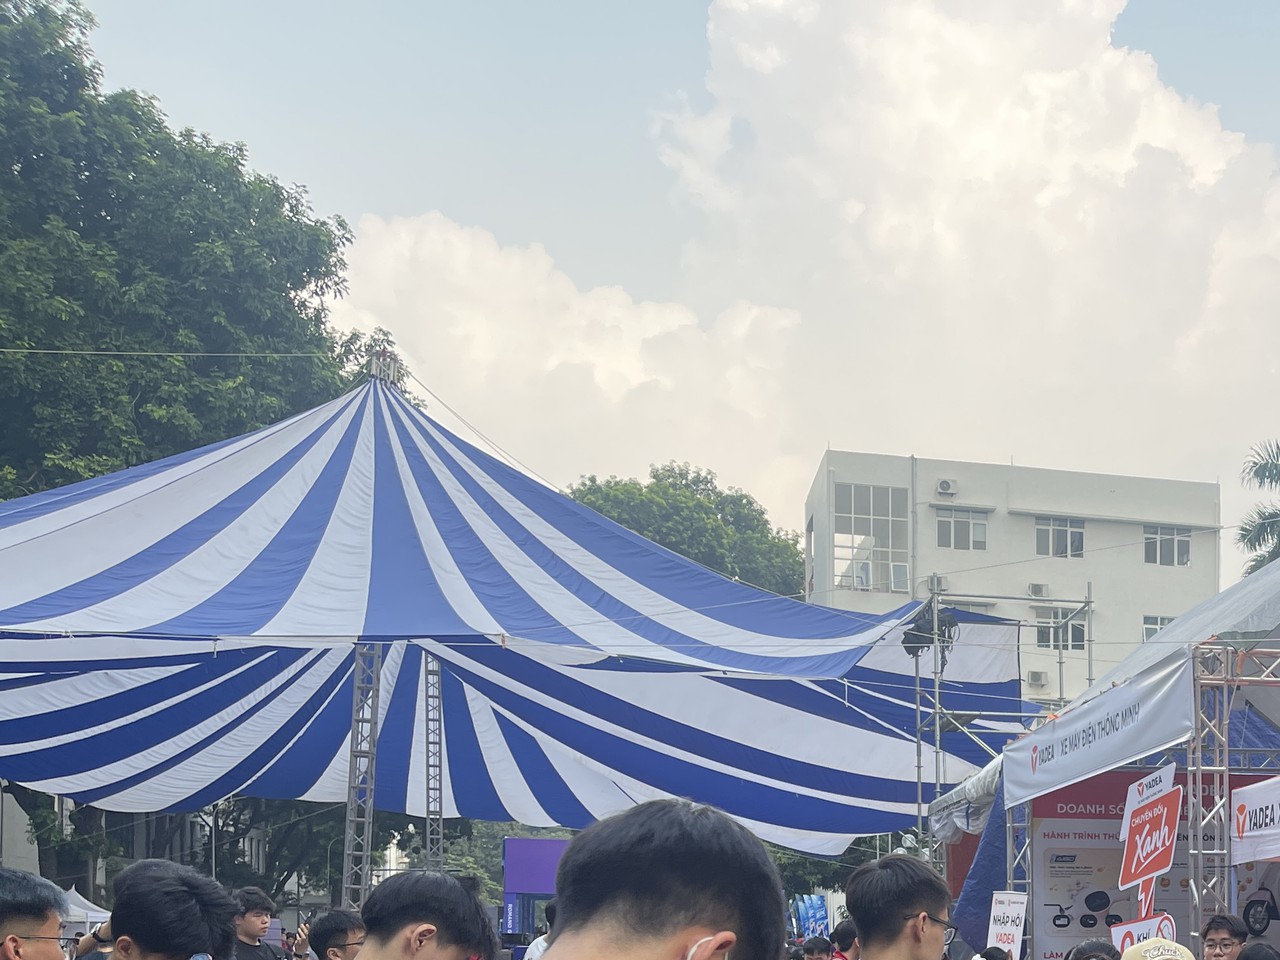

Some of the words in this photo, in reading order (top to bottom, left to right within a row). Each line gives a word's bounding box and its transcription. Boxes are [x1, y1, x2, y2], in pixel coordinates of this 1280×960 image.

[1038, 744, 1055, 766] YADEA
[1060, 738, 1068, 757] XE
[1082, 722, 1096, 749] ĐIỆN
[1097, 712, 1120, 740] THÔNG
[1120, 702, 1140, 730] MINH
[1144, 775, 1163, 792] YADEA
[1057, 803, 1105, 815] DOANH
[1131, 812, 1153, 828] CHUYỂN
[1153, 803, 1164, 819] ĐỔI
[1248, 803, 1275, 831] YADEA
[1043, 831, 1070, 840] HÀNH
[1073, 831, 1100, 841] TRÌNH
[1131, 806, 1176, 875] Xanh
[993, 912, 1010, 929] NHẬP
[1010, 913, 1023, 930] HỘI
[996, 932, 1015, 945] YADEA
